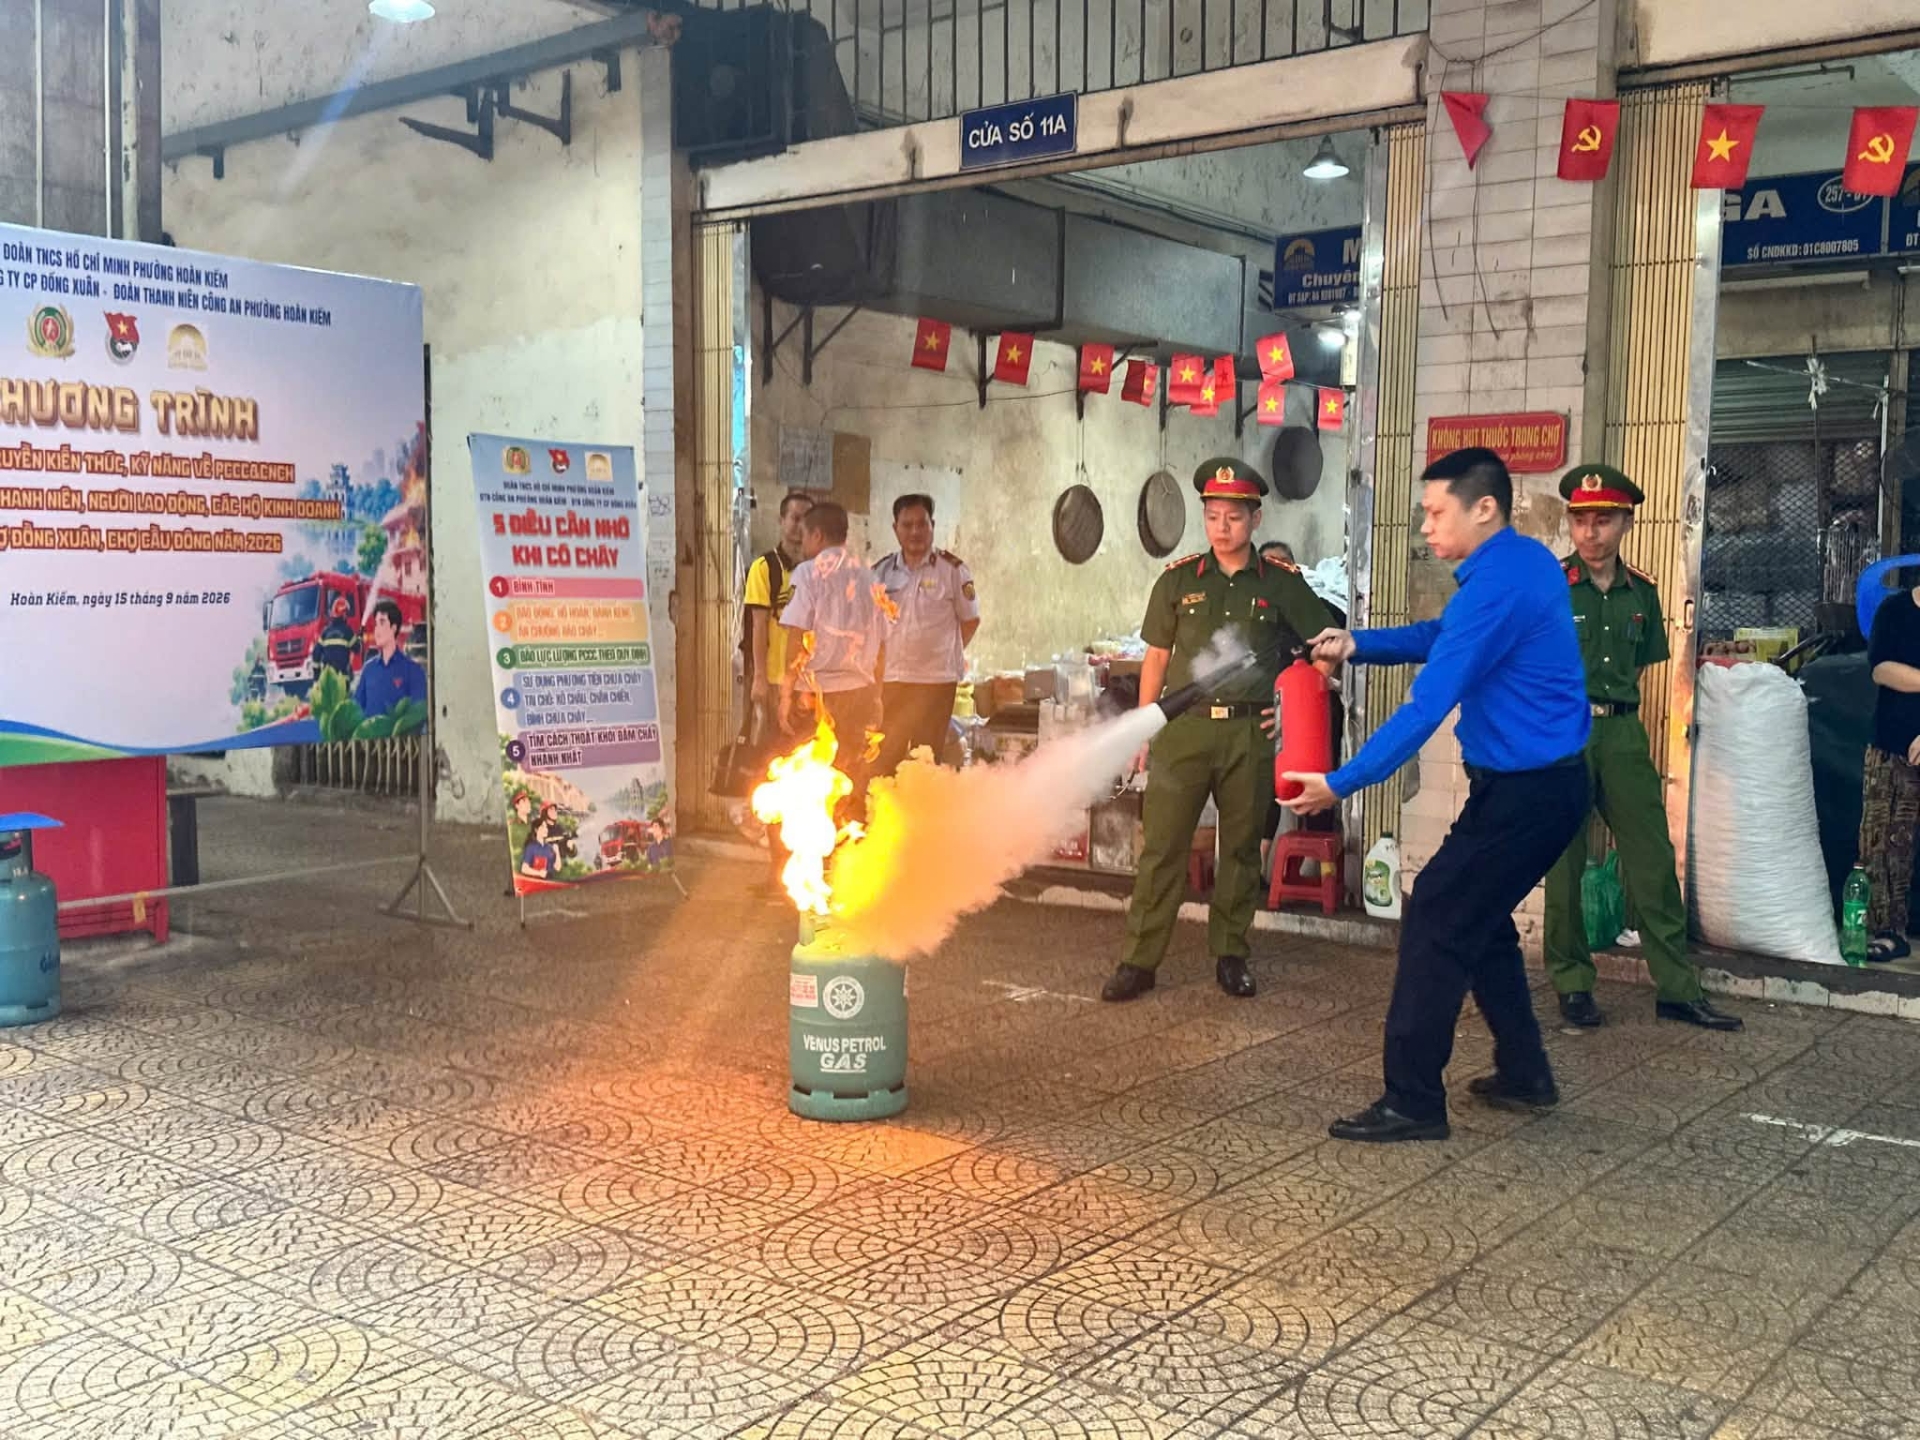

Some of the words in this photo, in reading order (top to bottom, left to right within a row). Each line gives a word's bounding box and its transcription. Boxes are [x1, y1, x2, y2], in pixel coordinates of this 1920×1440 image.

[969, 121, 1003, 148] CỬA
[1009, 112, 1034, 141] SỐ
[1040, 114, 1066, 136] 11A
[1748, 241, 1758, 260] SỐ
[4, 241, 32, 264] ĐOÀN
[36, 247, 62, 266] TNCS
[66, 250, 80, 269] HỒ
[83, 252, 100, 272] CHÍ
[103, 256, 130, 276] MINH
[134, 260, 173, 282] PHƯỜNG
[177, 263, 201, 286] HOÀN
[205, 268, 228, 289] KIẾM
[7, 270, 20, 288] TY
[24, 273, 37, 289] CP
[41, 271, 69, 294] ĐỒNG
[73, 275, 99, 297] XUÂN
[114, 282, 140, 302] ĐOÀN
[143, 287, 175, 307] THANH
[178, 289, 199, 309] NIÊN
[202, 292, 226, 313] CÔNG
[230, 299, 242, 315] AN
[245, 300, 281, 320] PHƯỜNG
[284, 304, 306, 324] HOÀN
[309, 307, 331, 326] KIẾM
[150, 386, 258, 440] TRÌNH
[1432, 426, 1460, 450] KHÔNG
[1463, 425, 1479, 448] HÚT
[1481, 421, 1509, 449] THUỐC
[1511, 426, 1540, 447] TRONG
[1541, 423, 1561, 445] CHỢ
[45, 444, 82, 472] KIẾN
[83, 450, 128, 477] THỨC,
[130, 451, 150, 476] KỸ
[152, 452, 191, 478] NĂNG
[192, 452, 212, 479] VỀ
[214, 459, 295, 483] PCCC&CNCH
[0, 487, 43, 510] HANH
[46, 485, 85, 513] NIÊN,
[88, 488, 134, 512] NGƯỜI
[136, 492, 165, 514] LAO
[166, 490, 210, 517] ĐỘNG,
[211, 492, 240, 516] CÁC
[241, 494, 262, 520] HỘ
[263, 498, 295, 519] KINH
[295, 500, 341, 520] DOANH
[493, 513, 505, 535] 5
[509, 508, 551, 536] ĐIỀU
[555, 510, 591, 538] CẦN
[10, 520, 55, 549] ĐỒNG
[58, 524, 104, 552] XUÂN,
[106, 528, 139, 553] CHỢ
[140, 523, 171, 550] CẦU
[173, 527, 212, 551] ĐÔNG
[214, 528, 245, 552] NĂM
[246, 533, 282, 553] 2026
[512, 545, 542, 567] KHI
[546, 543, 571, 568] CÓ
[10, 592, 43, 606] Hoàn
[82, 592, 112, 608] ngày
[115, 592, 128, 605] 15
[130, 591, 163, 607] tháng
[166, 592, 173, 605] 9
[176, 592, 199, 605] năm
[201, 592, 231, 604] 2026
[503, 653, 510, 664] 3
[506, 692, 513, 705] 4
[512, 745, 520, 757] 5
[529, 734, 544, 747] TÌM
[547, 733, 568, 747] CÁCH
[570, 730, 595, 746] THOÁT
[531, 753, 559, 766] NHANH
[803, 1034, 840, 1053] VENUS
[841, 1036, 886, 1053] PETROL
[820, 1053, 867, 1069] GAS
